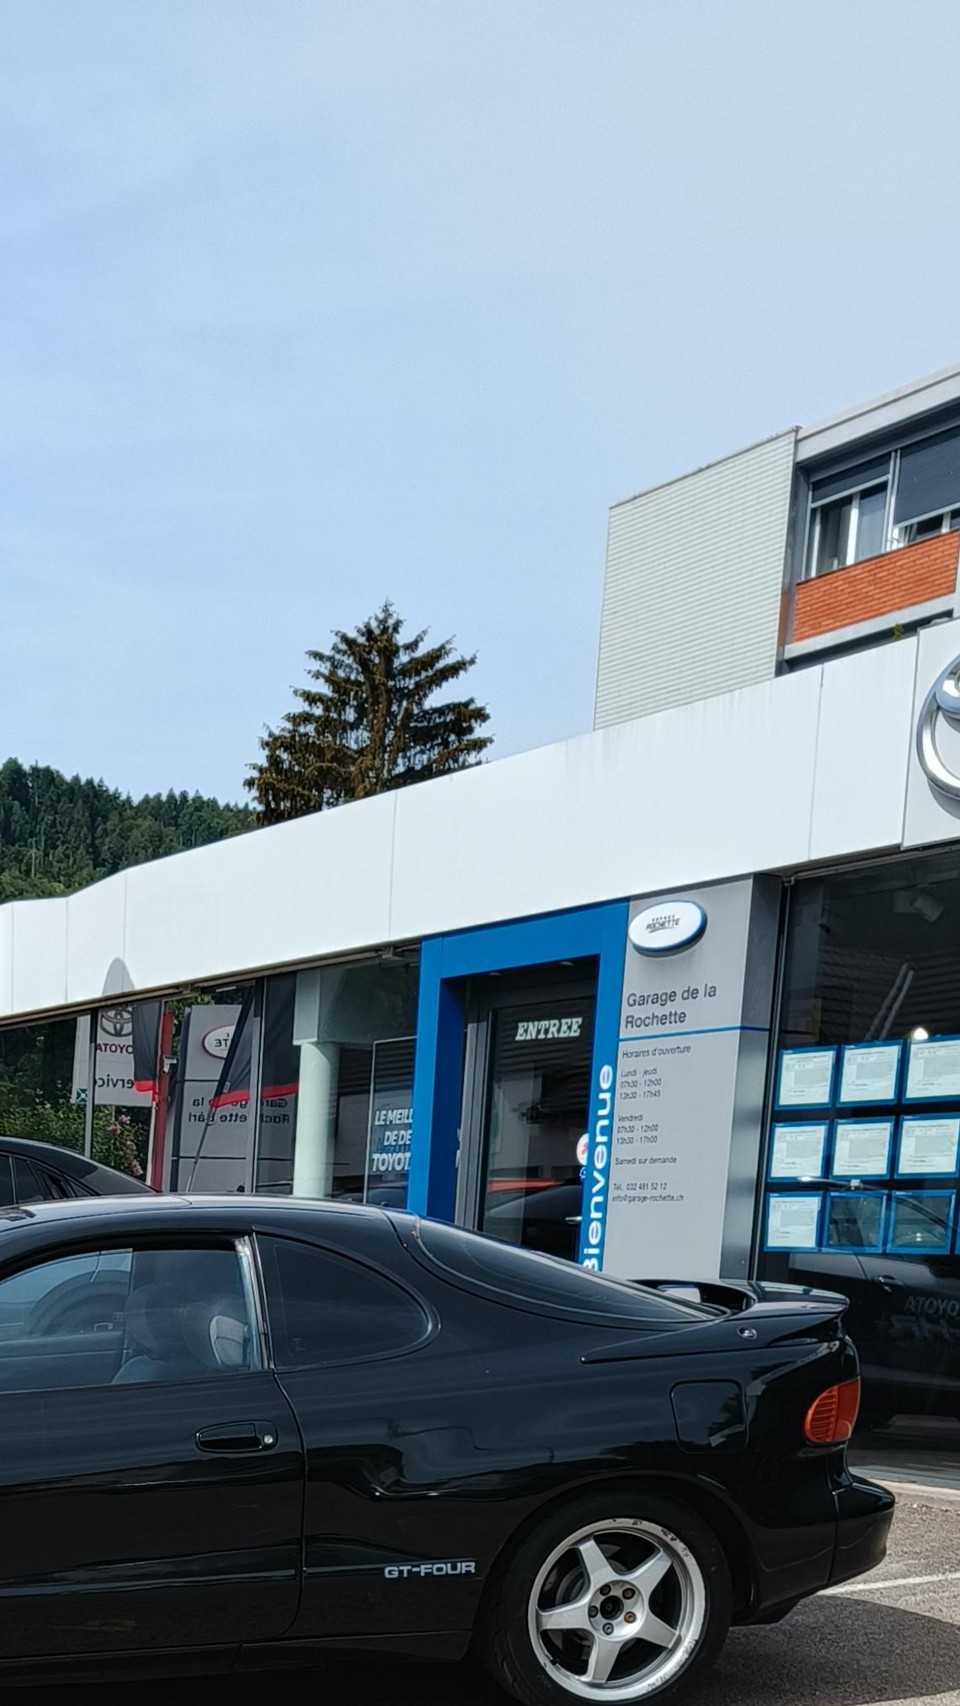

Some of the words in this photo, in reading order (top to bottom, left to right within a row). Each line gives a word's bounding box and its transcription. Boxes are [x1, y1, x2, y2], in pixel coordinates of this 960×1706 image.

[626, 990, 677, 1008] Garage
[681, 985, 700, 1001] de
[703, 983, 717, 998] la
[625, 1010, 687, 1029] Rochette
[514, 1017, 582, 1042] ENTREE
[622, 1048, 650, 1059] Horaires
[374, 1110, 387, 1126] LE
[386, 1108, 414, 1125] MEILL
[383, 1130, 398, 1146] DE
[372, 1151, 412, 1172] TOYOT
[383, 1561, 476, 1579] GT-FOUR
